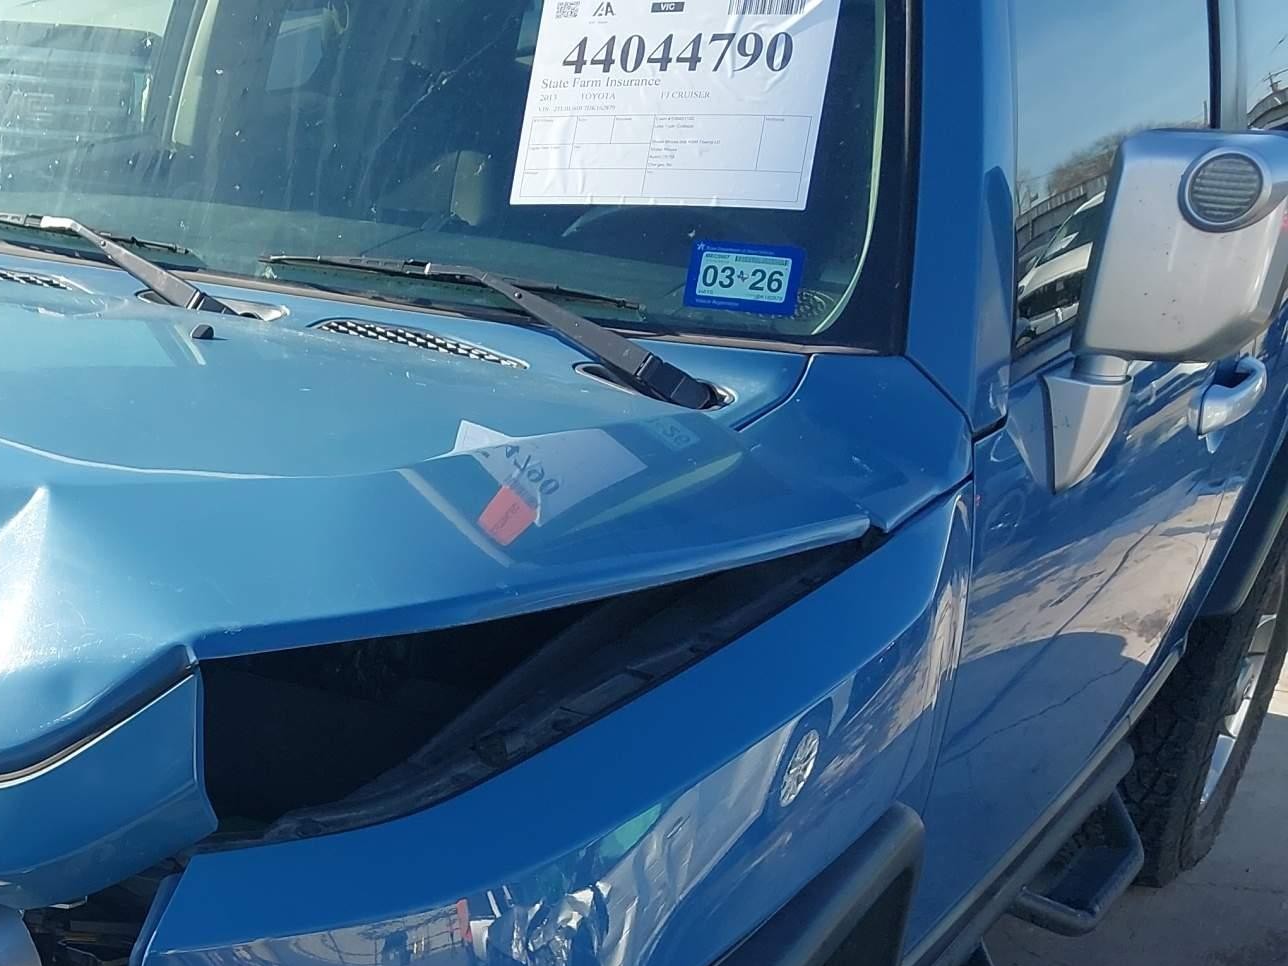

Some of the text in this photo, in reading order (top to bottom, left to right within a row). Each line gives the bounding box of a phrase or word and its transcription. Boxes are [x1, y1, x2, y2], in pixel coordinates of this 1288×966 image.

[562, 32, 794, 74] 44044790
[541, 76, 661, 89] State Farm Insurance
[581, 92, 616, 101] TOYOTA
[671, 90, 710, 99] CRUISER
[702, 264, 784, 293] 03 26
